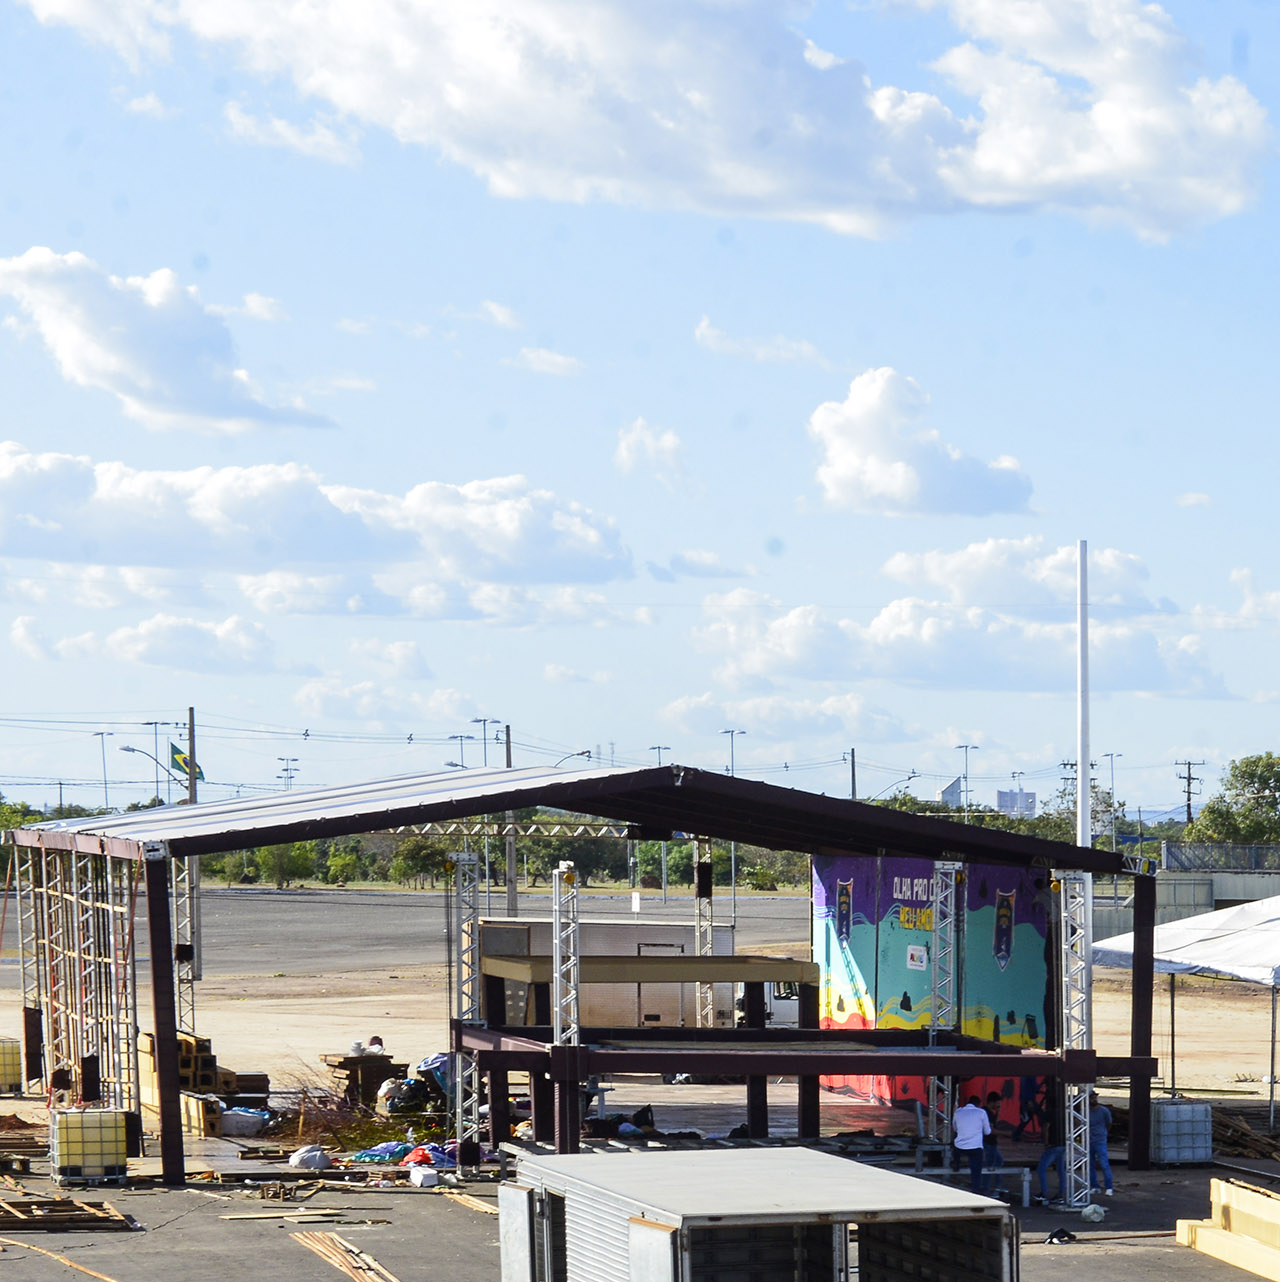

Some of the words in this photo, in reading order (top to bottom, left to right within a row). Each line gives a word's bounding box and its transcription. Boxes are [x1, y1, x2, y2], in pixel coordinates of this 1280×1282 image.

[893, 877, 911, 899] OLHA
[913, 879, 927, 900] PRO
[900, 907, 914, 930] MEU
